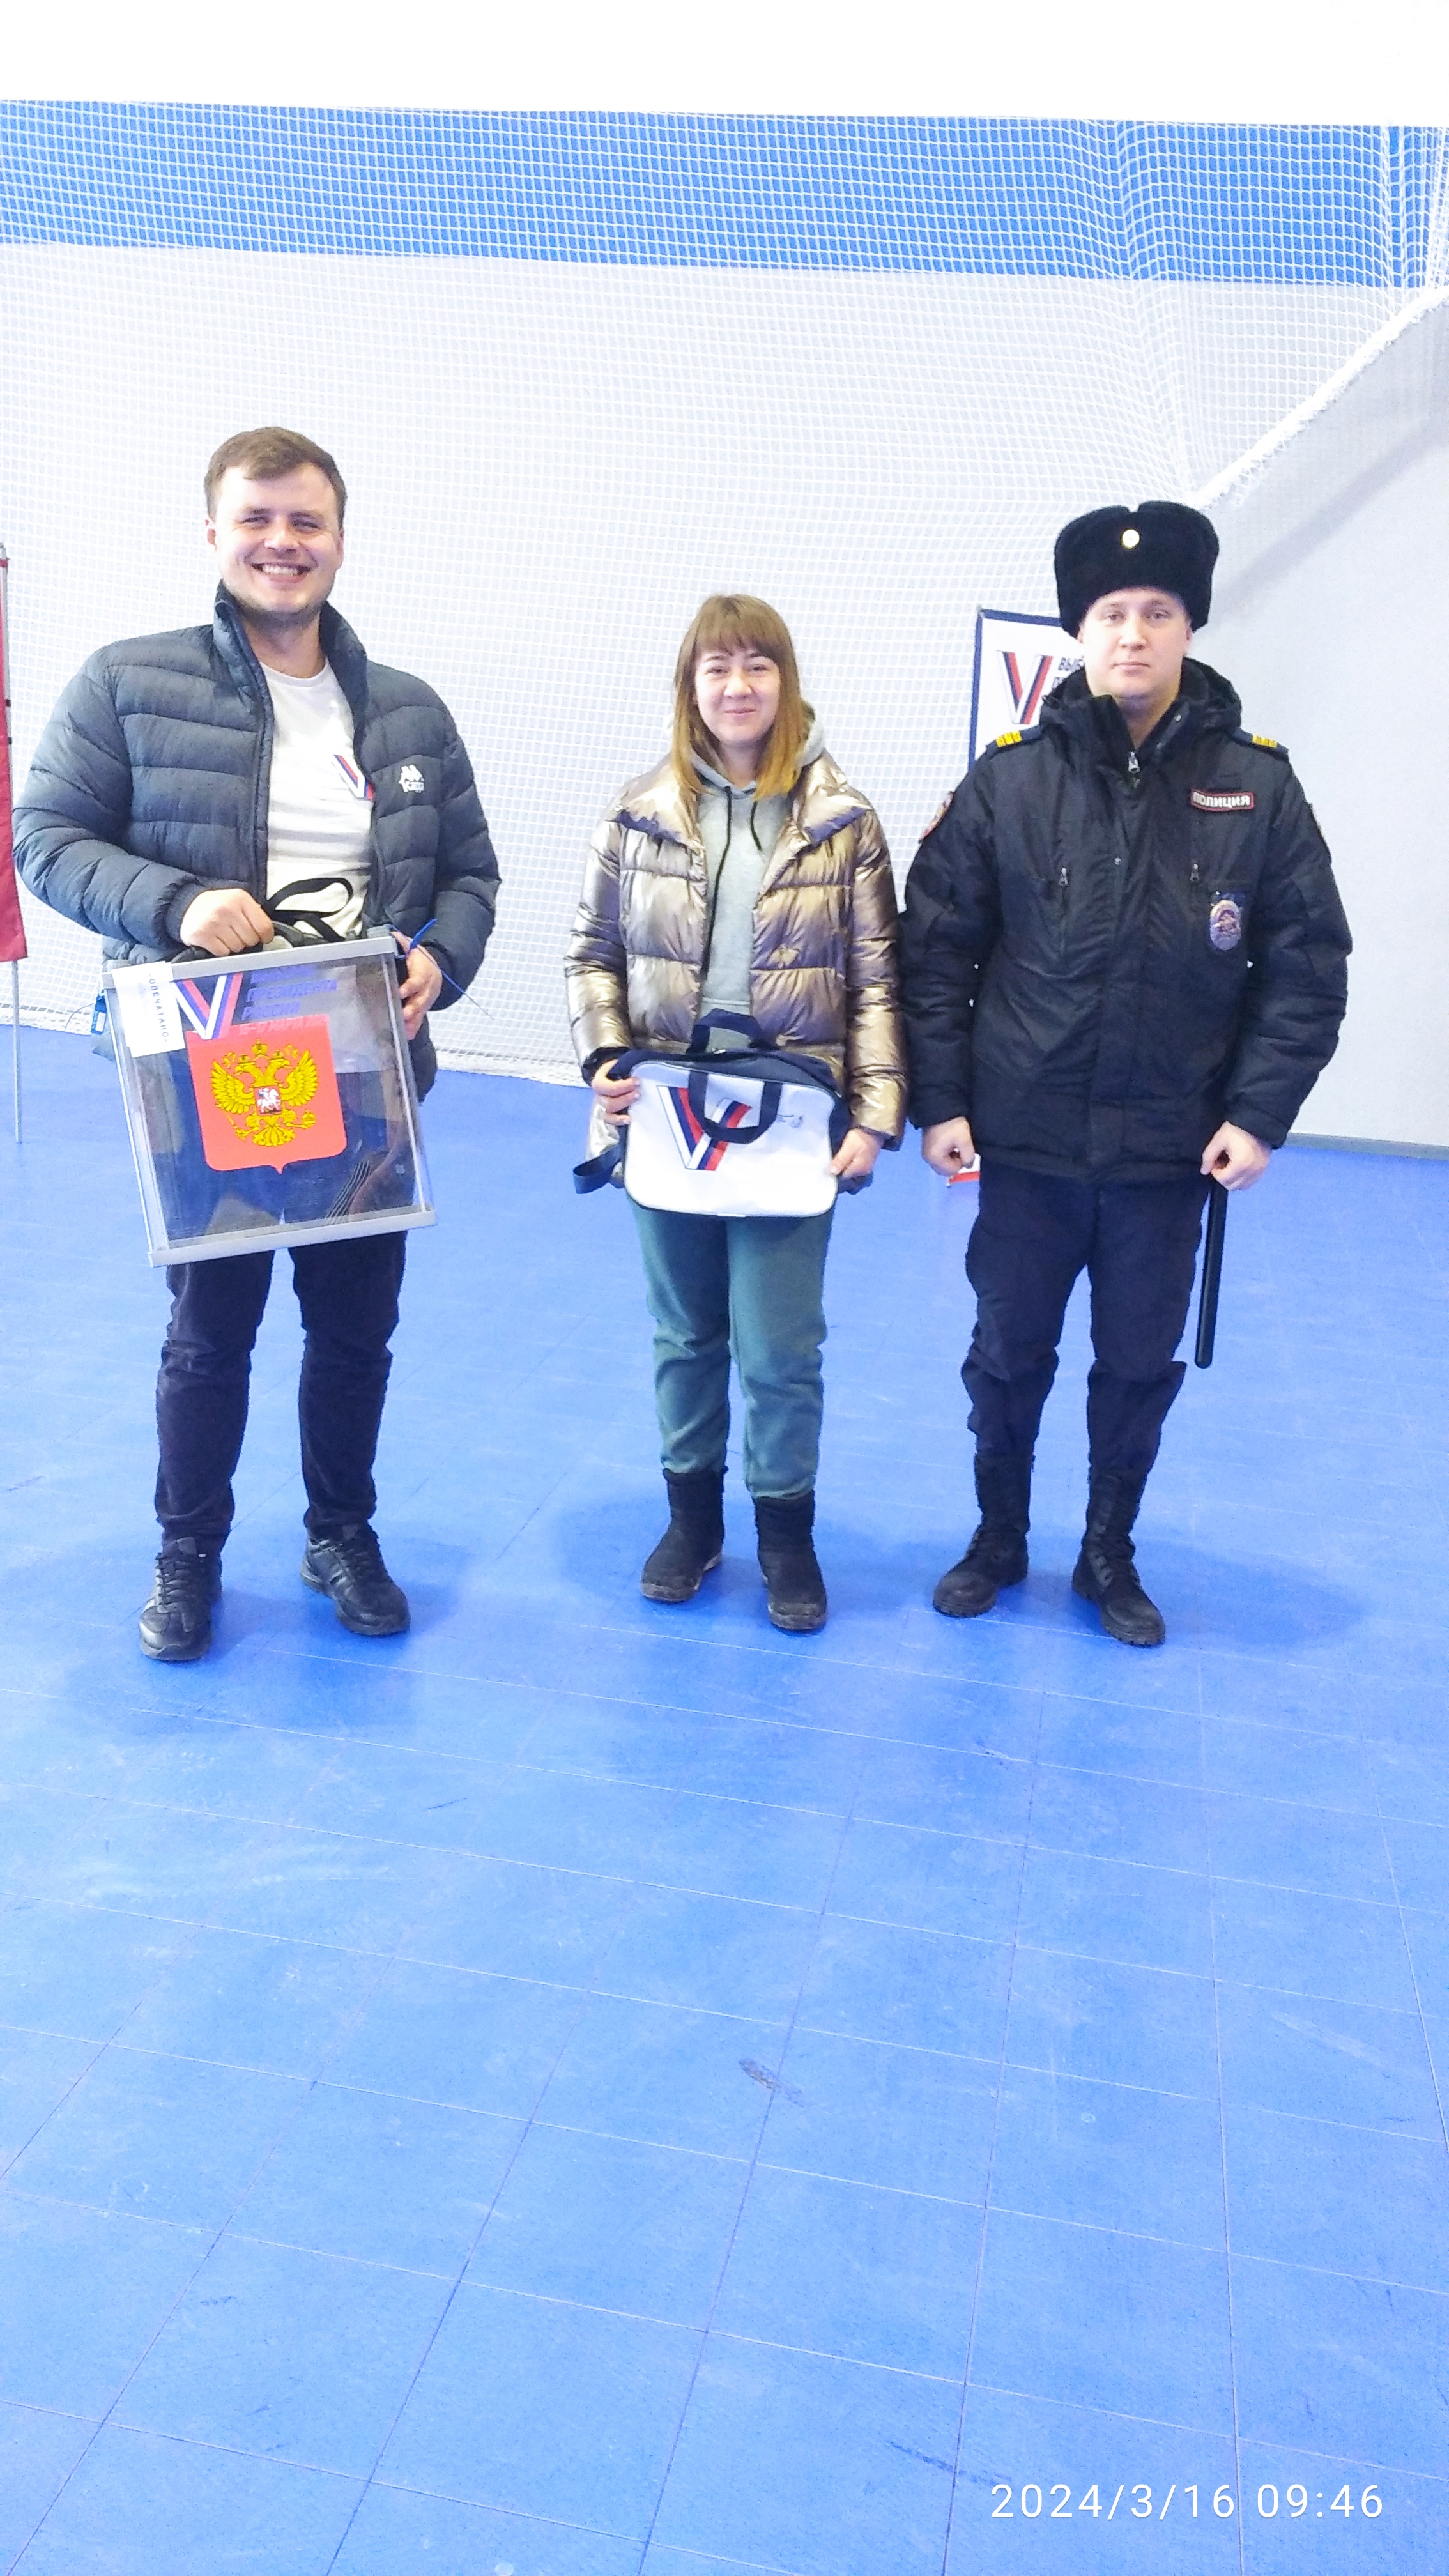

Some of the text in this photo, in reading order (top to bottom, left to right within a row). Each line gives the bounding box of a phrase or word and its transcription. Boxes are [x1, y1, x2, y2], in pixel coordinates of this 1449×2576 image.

[1057, 656, 1084, 673] ВЫБ
[1192, 792, 1251, 809] ПОЛИЦИЯ
[149, 978, 169, 1038] ОПЕЧАТАНО
